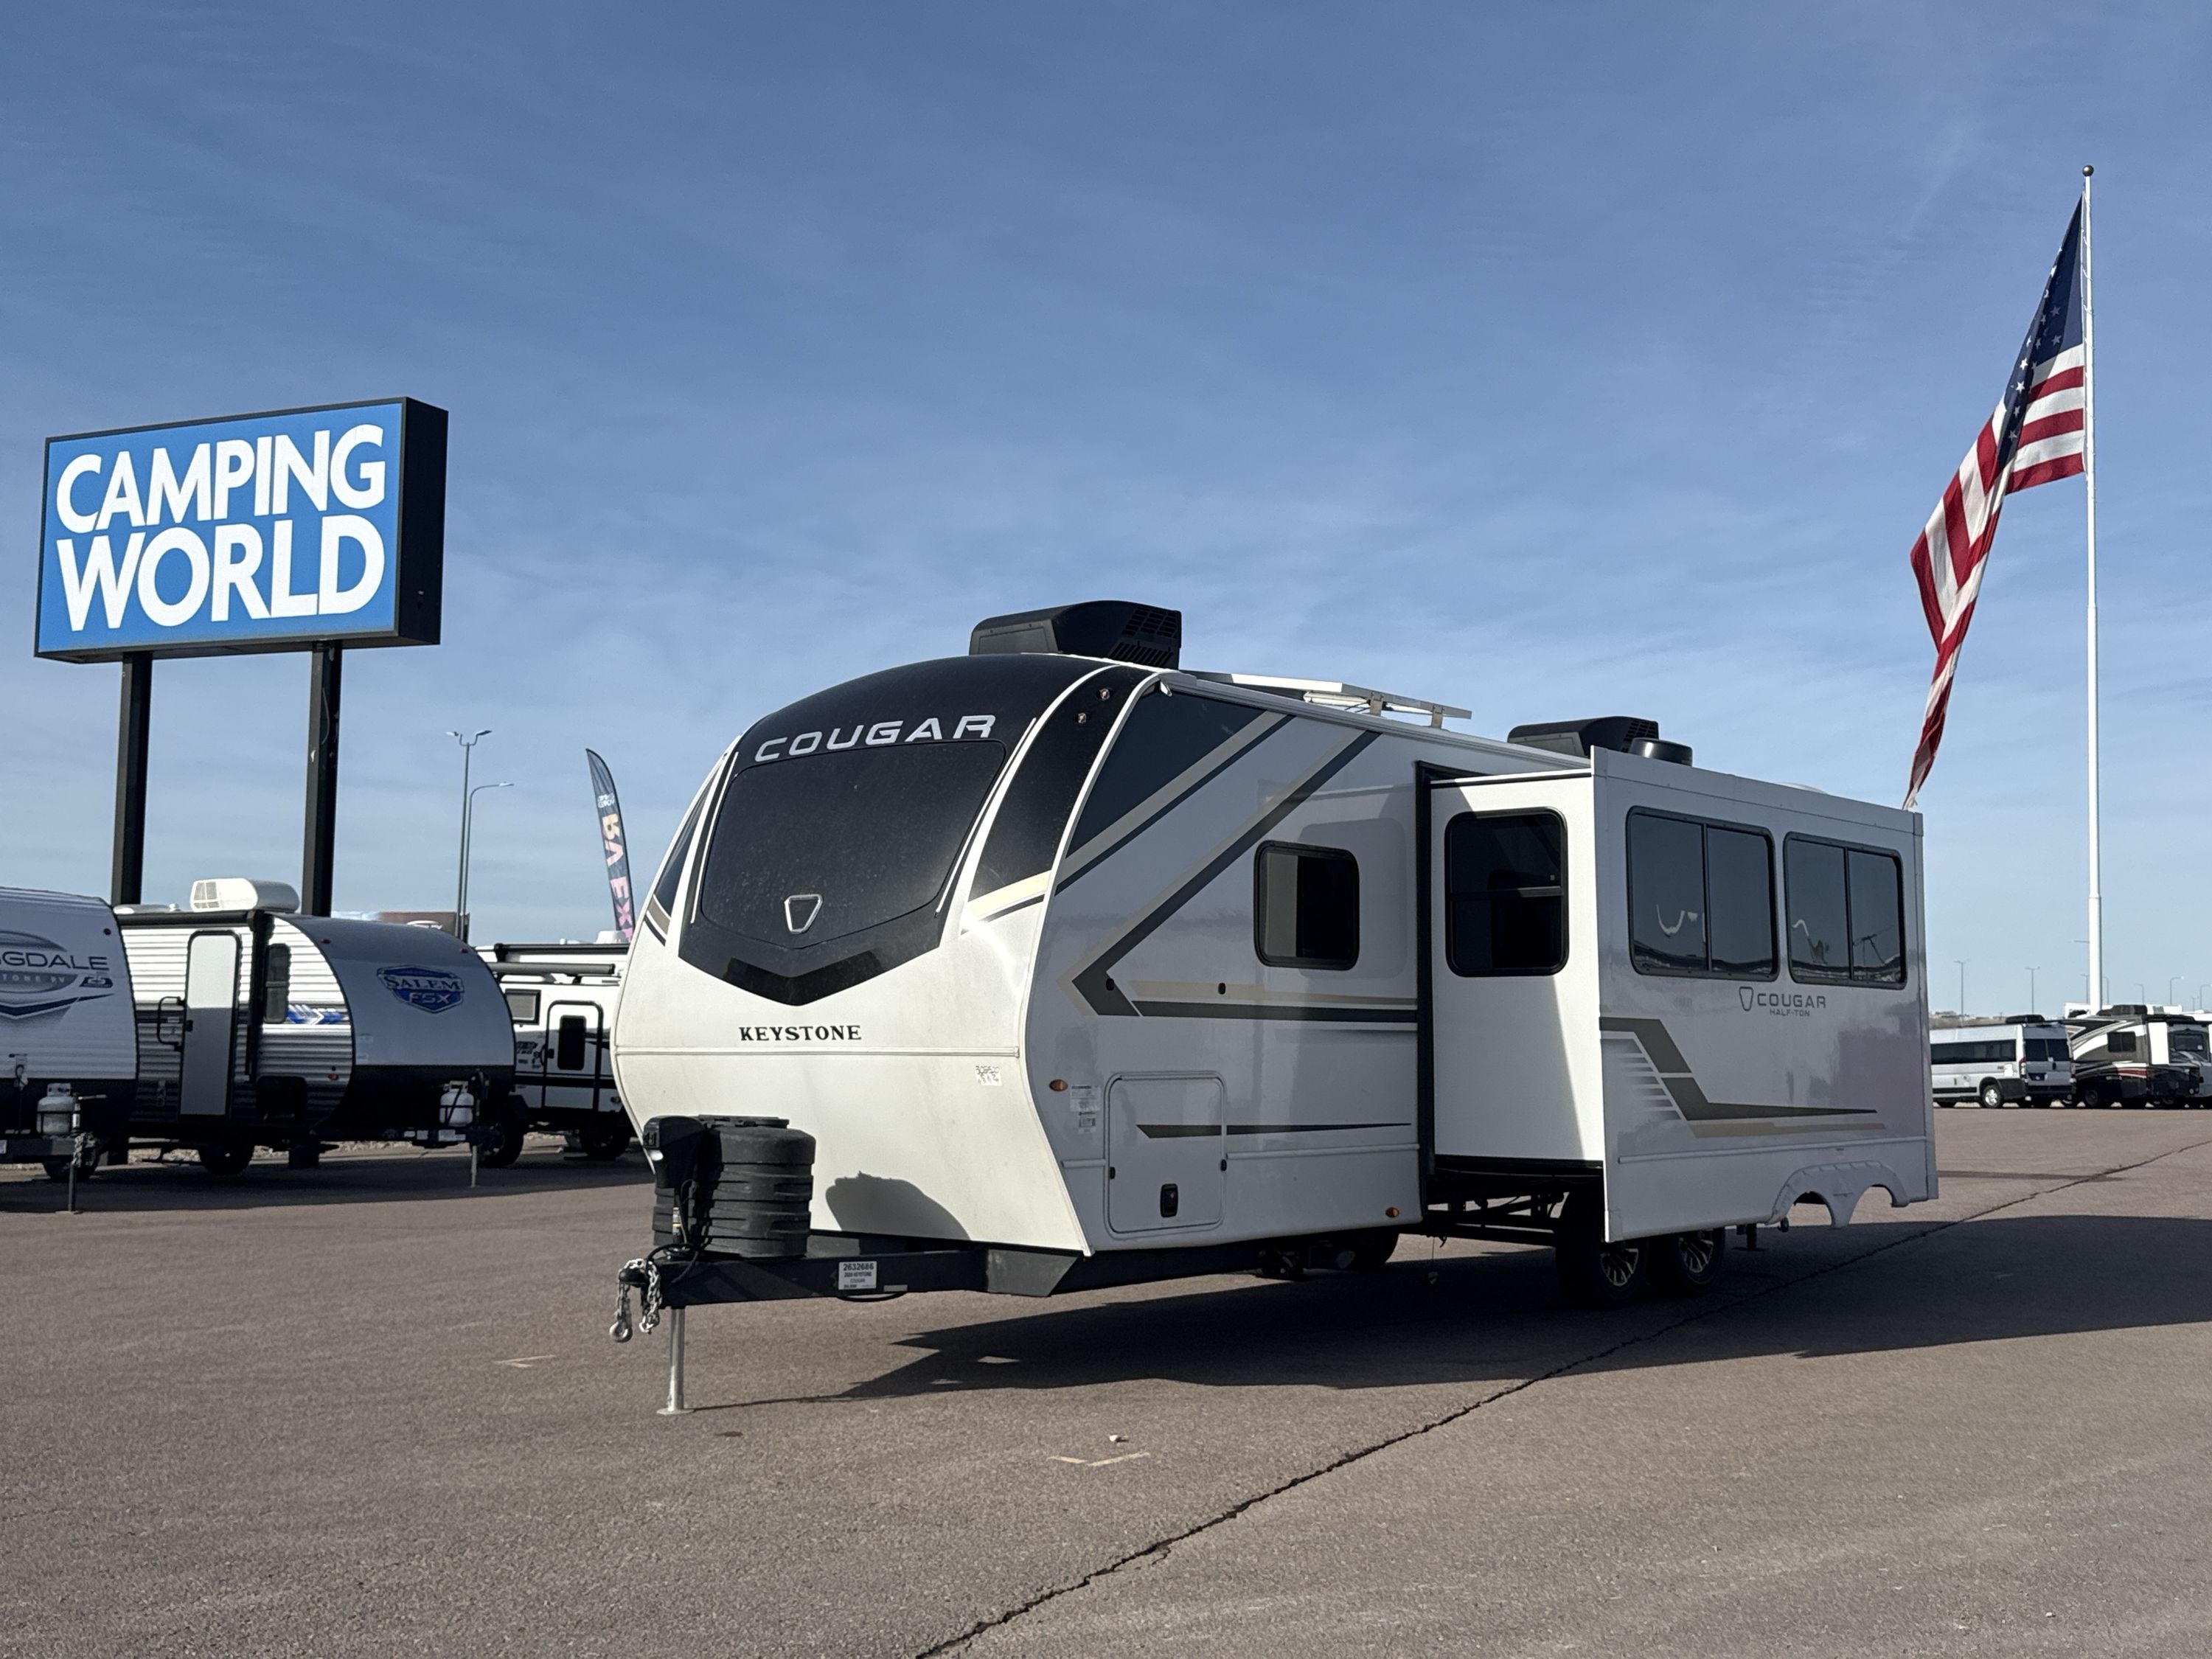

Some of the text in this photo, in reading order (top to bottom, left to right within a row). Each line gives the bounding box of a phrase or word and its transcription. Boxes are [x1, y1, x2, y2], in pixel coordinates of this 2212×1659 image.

[56, 423, 386, 533] CAMPING
[56, 514, 385, 631] WORLD
[754, 714, 996, 762] COUGAR
[0, 951, 110, 971] GDALE
[49, 975, 66, 984] RV
[383, 975, 461, 990] SALEM
[408, 992, 450, 1004] FSX
[1757, 992, 1826, 1009] COUGAR
[1770, 1008, 1811, 1017] HALF-TON
[739, 1025, 862, 1041] KEYSTONE
